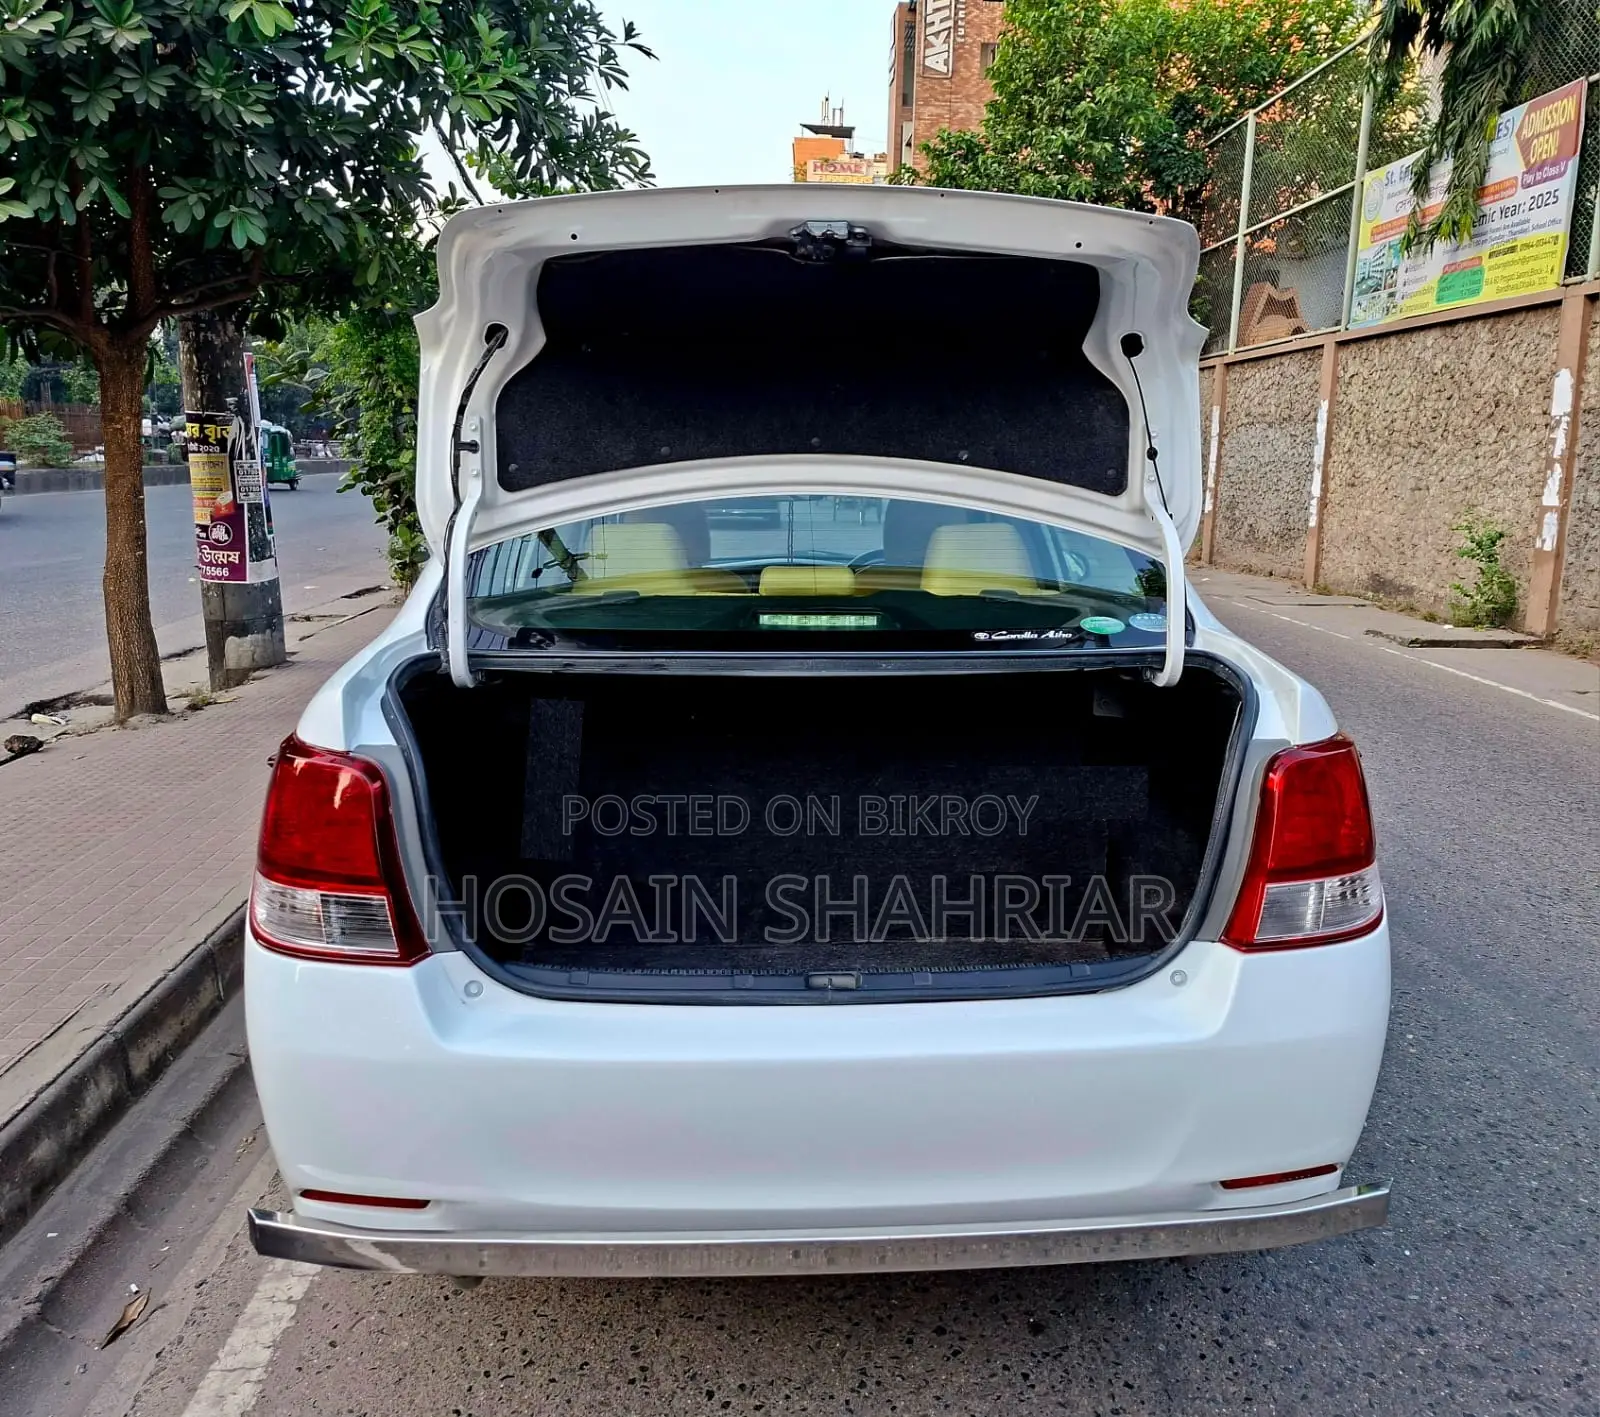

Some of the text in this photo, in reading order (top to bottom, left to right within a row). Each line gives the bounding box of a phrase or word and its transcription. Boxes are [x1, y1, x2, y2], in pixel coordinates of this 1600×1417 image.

[1521, 94, 1577, 140] ADMISSION
[1529, 130, 1560, 164] OPEN!
[812, 161, 865, 174] HOME
[1522, 171, 1535, 184] Play
[1543, 165, 1560, 178] Class
[1560, 161, 1566, 173] V
[1472, 207, 1497, 228] emic
[1499, 201, 1527, 219] Year:
[1528, 188, 1560, 212] 2025
[200, 564, 230, 577] 75566
[991, 630, 1038, 640] Corolla
